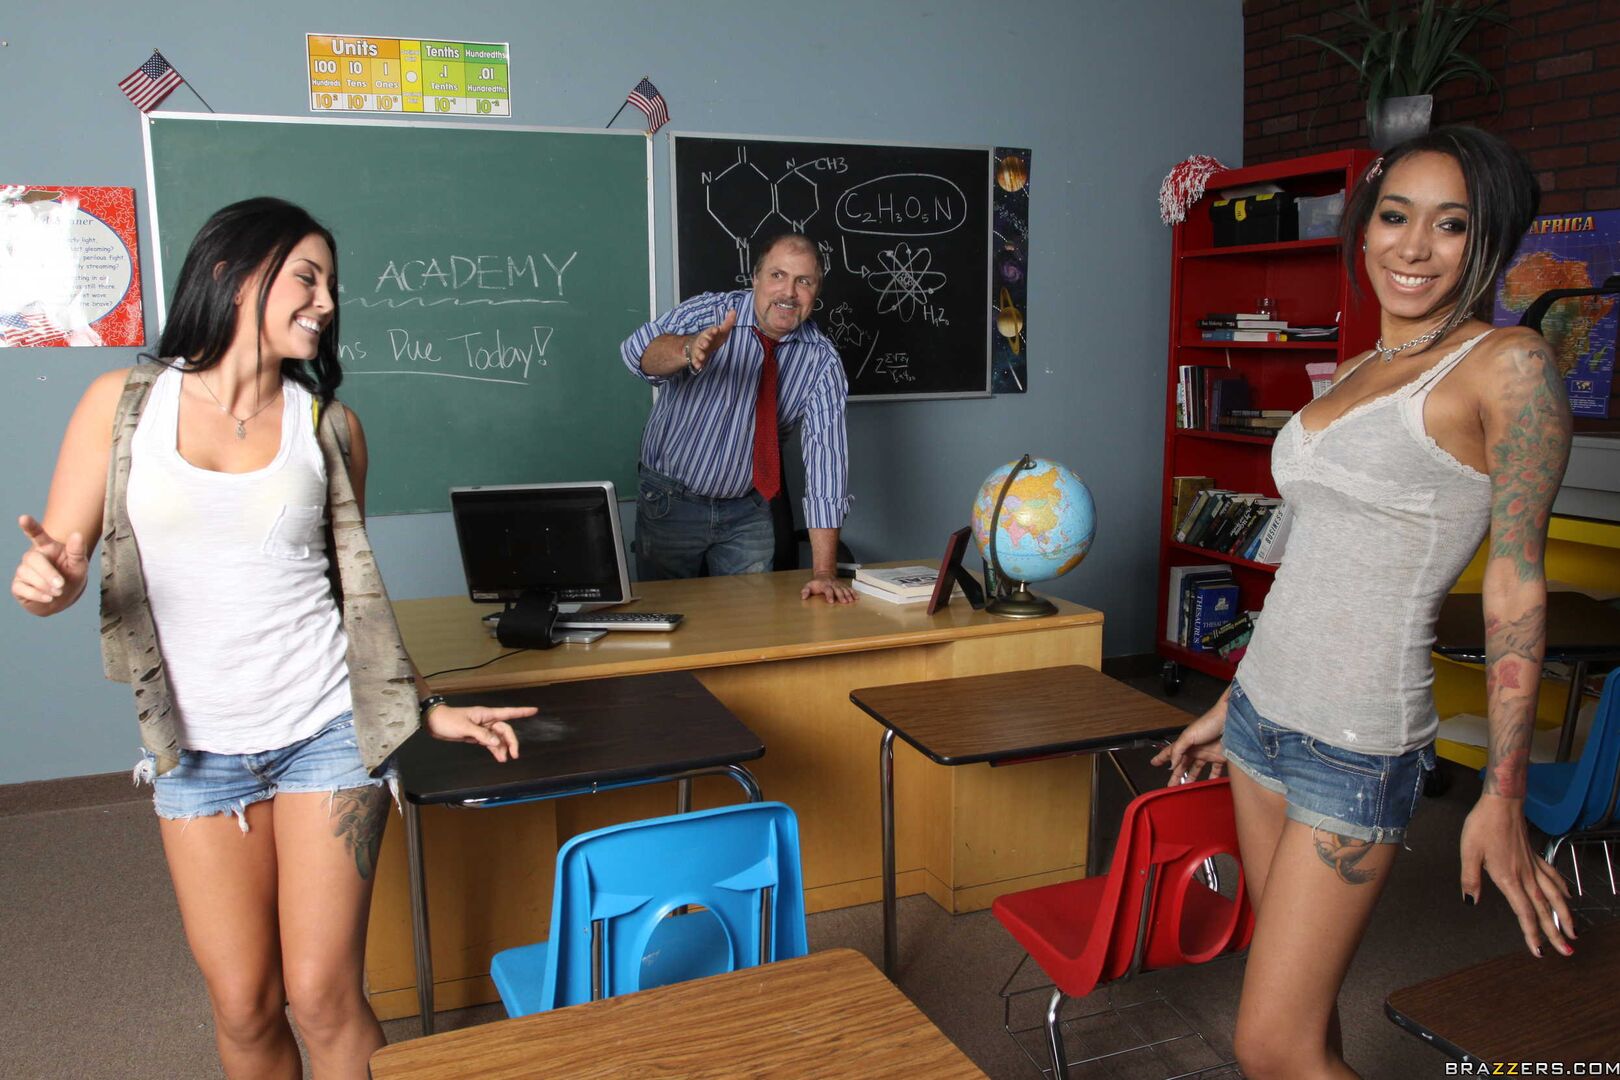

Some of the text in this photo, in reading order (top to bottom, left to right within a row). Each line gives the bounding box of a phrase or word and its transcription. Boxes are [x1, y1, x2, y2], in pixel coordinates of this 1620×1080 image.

[332, 39, 378, 57] Units
[425, 45, 460, 59] Tenths
[465, 49, 507, 60] Hundredths
[314, 60, 337, 74] 100
[349, 61, 363, 75] 10
[479, 67, 495, 80] .01
[312, 79, 341, 88] Hundreds
[346, 80, 368, 88] Tens
[375, 80, 400, 88] Ones
[431, 82, 458, 91] Tenths
[467, 84, 507, 93] Hundredths
[701, 171, 712, 184] N
[1529, 216, 1595, 235] AFRICA
[375, 251, 577, 296] ACADEMY
[338, 326, 553, 378] ns Due Today!
[1265, 511, 1284, 545] BUSINESS
[1193, 594, 1203, 644] THESAURUS
